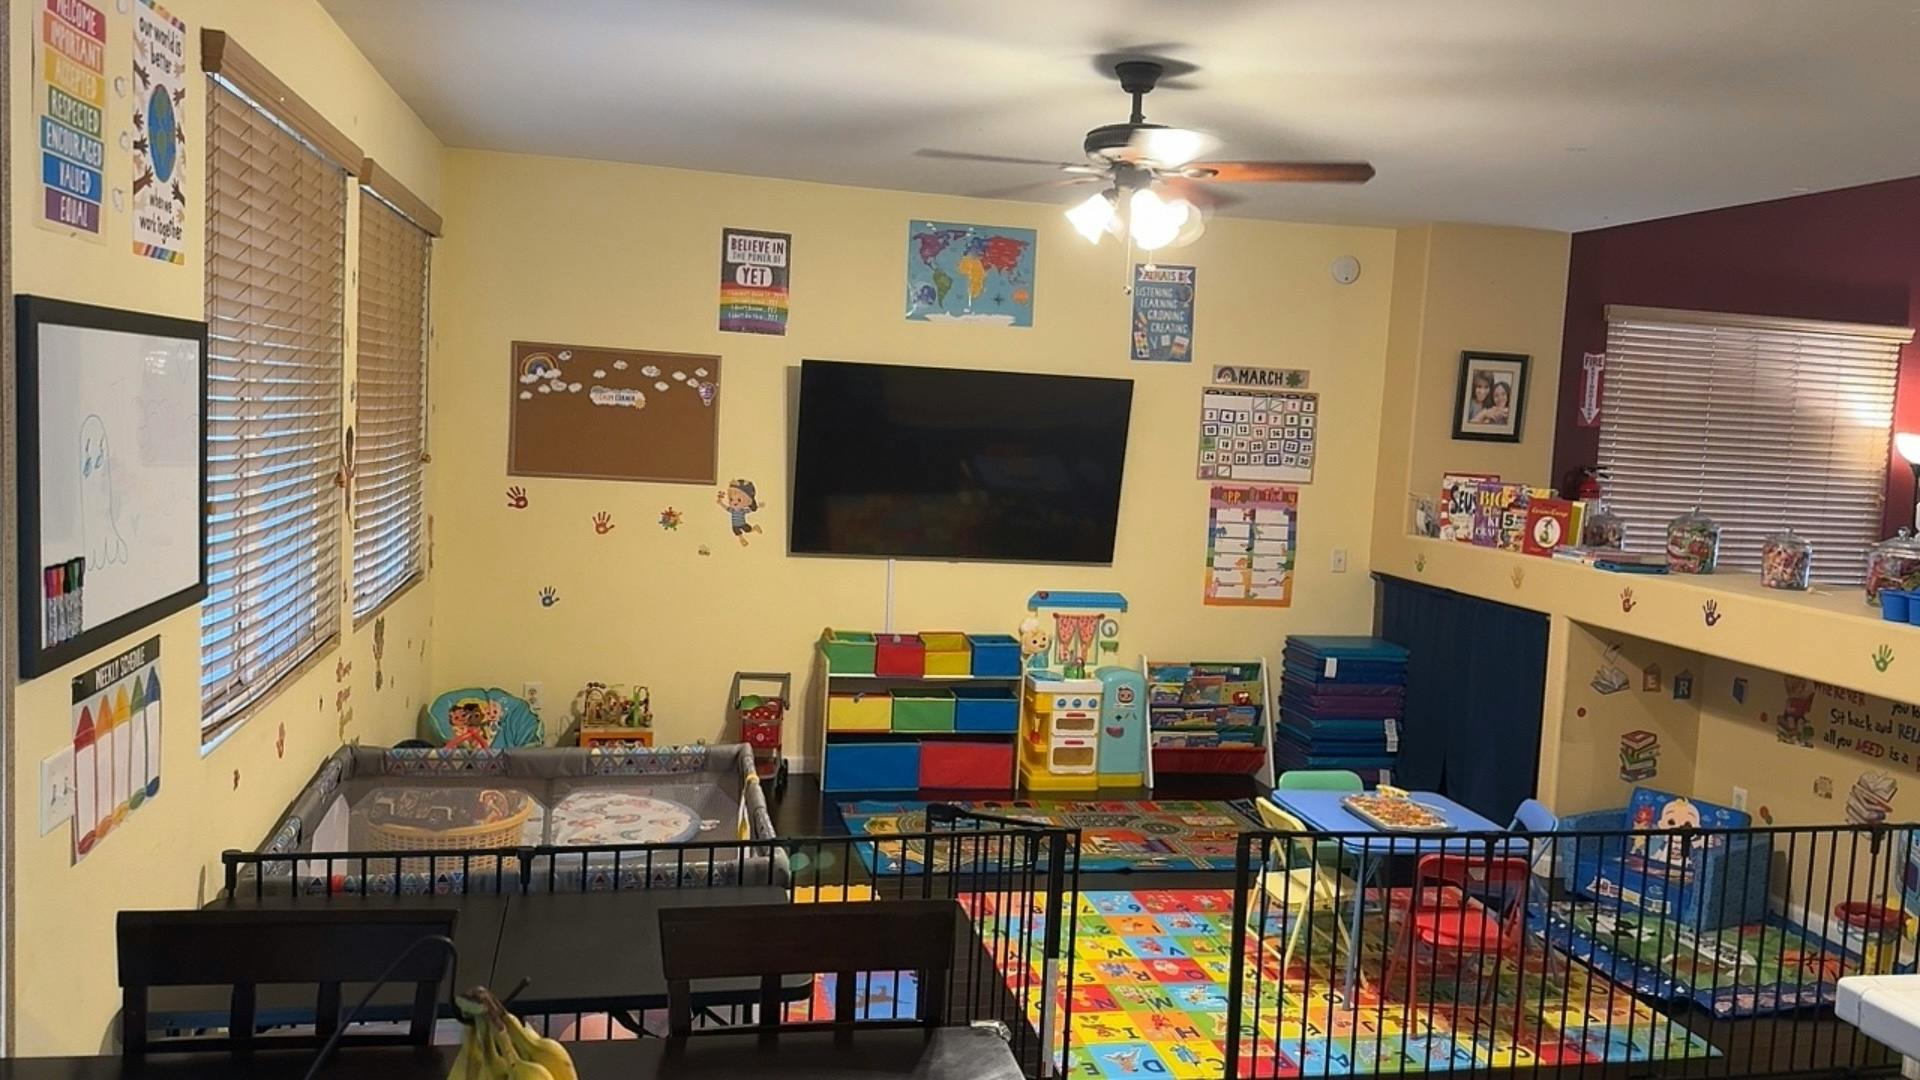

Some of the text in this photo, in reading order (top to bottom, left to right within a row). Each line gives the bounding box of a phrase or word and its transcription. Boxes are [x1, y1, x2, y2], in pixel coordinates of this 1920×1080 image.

[154, 26, 175, 54] world
[151, 41, 172, 74] better
[51, 88, 99, 134] RESPECTED
[60, 160, 92, 195] VALUED
[61, 195, 88, 228] EQUAL
[139, 212, 182, 244] work together
[731, 238, 784, 255] BELIEVE IN
[742, 267, 767, 285] YET
[1585, 357, 1602, 367] FIRE
[1239, 369, 1284, 385] MARCH
[1647, 675, 1658, 688] E
[1679, 681, 1689, 695] R
[1847, 710, 1873, 732] back
[1874, 719, 1893, 734] and
[1898, 723, 1920, 744] REL
[1823, 728, 1836, 745] all
[1836, 736, 1853, 750] you
[1855, 738, 1885, 758] NEED
[1889, 746, 1900, 761] is
[1107, 948, 1132, 959] W
[1169, 946, 1185, 956] V
[1079, 972, 1096, 982] S
[1132, 970, 1151, 981] R
[1093, 998, 1117, 1009] N
[1147, 997, 1173, 1009] M
[1122, 1027, 1140, 1039] I
[1175, 1026, 1201, 1039] H
[1080, 1062, 1100, 1075] E
[1142, 1059, 1166, 1073] D
